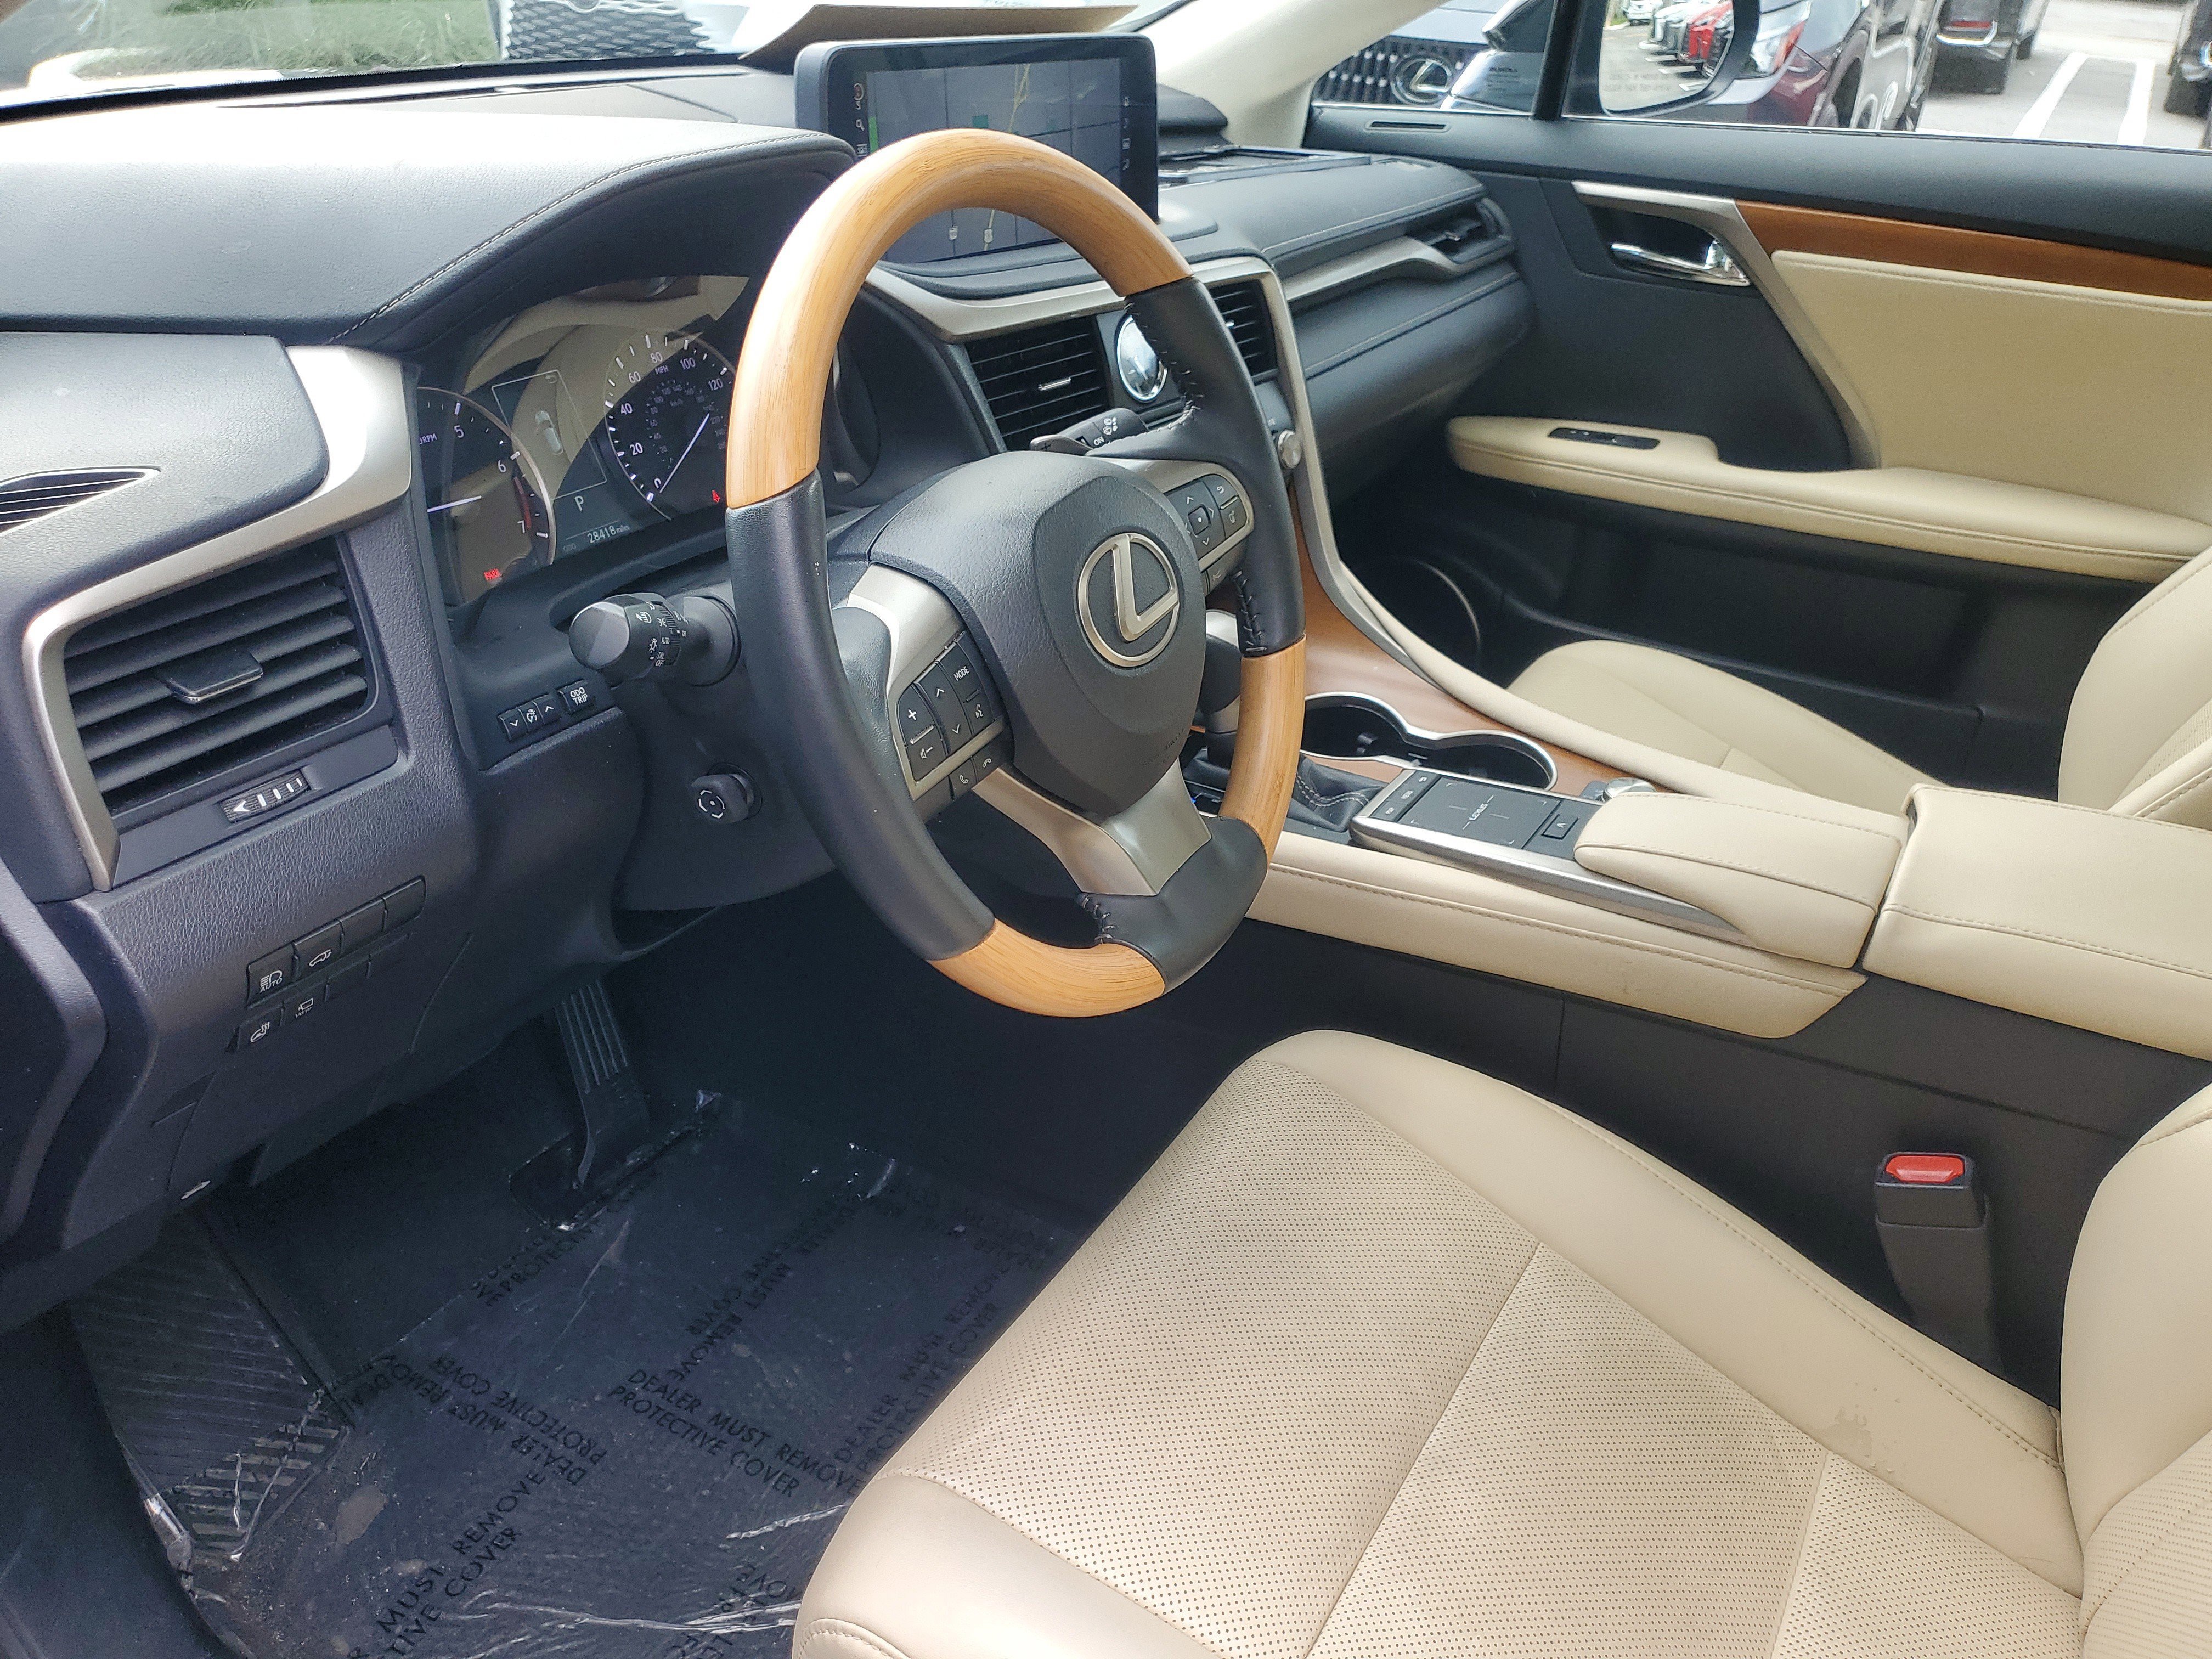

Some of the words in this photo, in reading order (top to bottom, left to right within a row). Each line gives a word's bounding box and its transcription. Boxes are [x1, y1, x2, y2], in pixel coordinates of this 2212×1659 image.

[650, 352, 663, 363] 80
[680, 357, 696, 370] 100
[629, 371, 641, 383] 60
[654, 365, 669, 375] MPH
[707, 377, 724, 391] 120
[620, 402, 633, 415] 40
[454, 424, 465, 439] 5
[629, 442, 644, 456] 20
[1093, 436, 1105, 446] ON
[497, 459, 507, 473] 6
[574, 495, 585, 512] P
[517, 519, 526, 534] 7
[587, 525, 617, 544] 28418
[953, 665, 970, 681] MODE
[570, 687, 585, 698] ODO
[573, 693, 589, 707] TRIP
[259, 977, 283, 994] AUTO
[295, 1006, 313, 1019] VIEW
[744, 1262, 791, 1310] MUST
[948, 1302, 1003, 1355] COVER
[667, 1312, 742, 1382] REMOVE
[428, 1356, 492, 1396] COVER
[447, 1403, 507, 1435] MUST
[491, 1390, 607, 1465] PROTECTIVE
[628, 1369, 702, 1414] DEALER
[707, 1410, 772, 1448] MUST
[775, 1442, 862, 1497] REMOVE
[834, 1393, 899, 1464] DEALER
[606, 1385, 728, 1456] PROTECTIVE
[730, 1449, 800, 1498] COVER
[511, 1434, 587, 1485] DEALER
[375, 1566, 444, 1634] MUST
[450, 1473, 546, 1555] REMOVE
[444, 1527, 523, 1597] COVER
